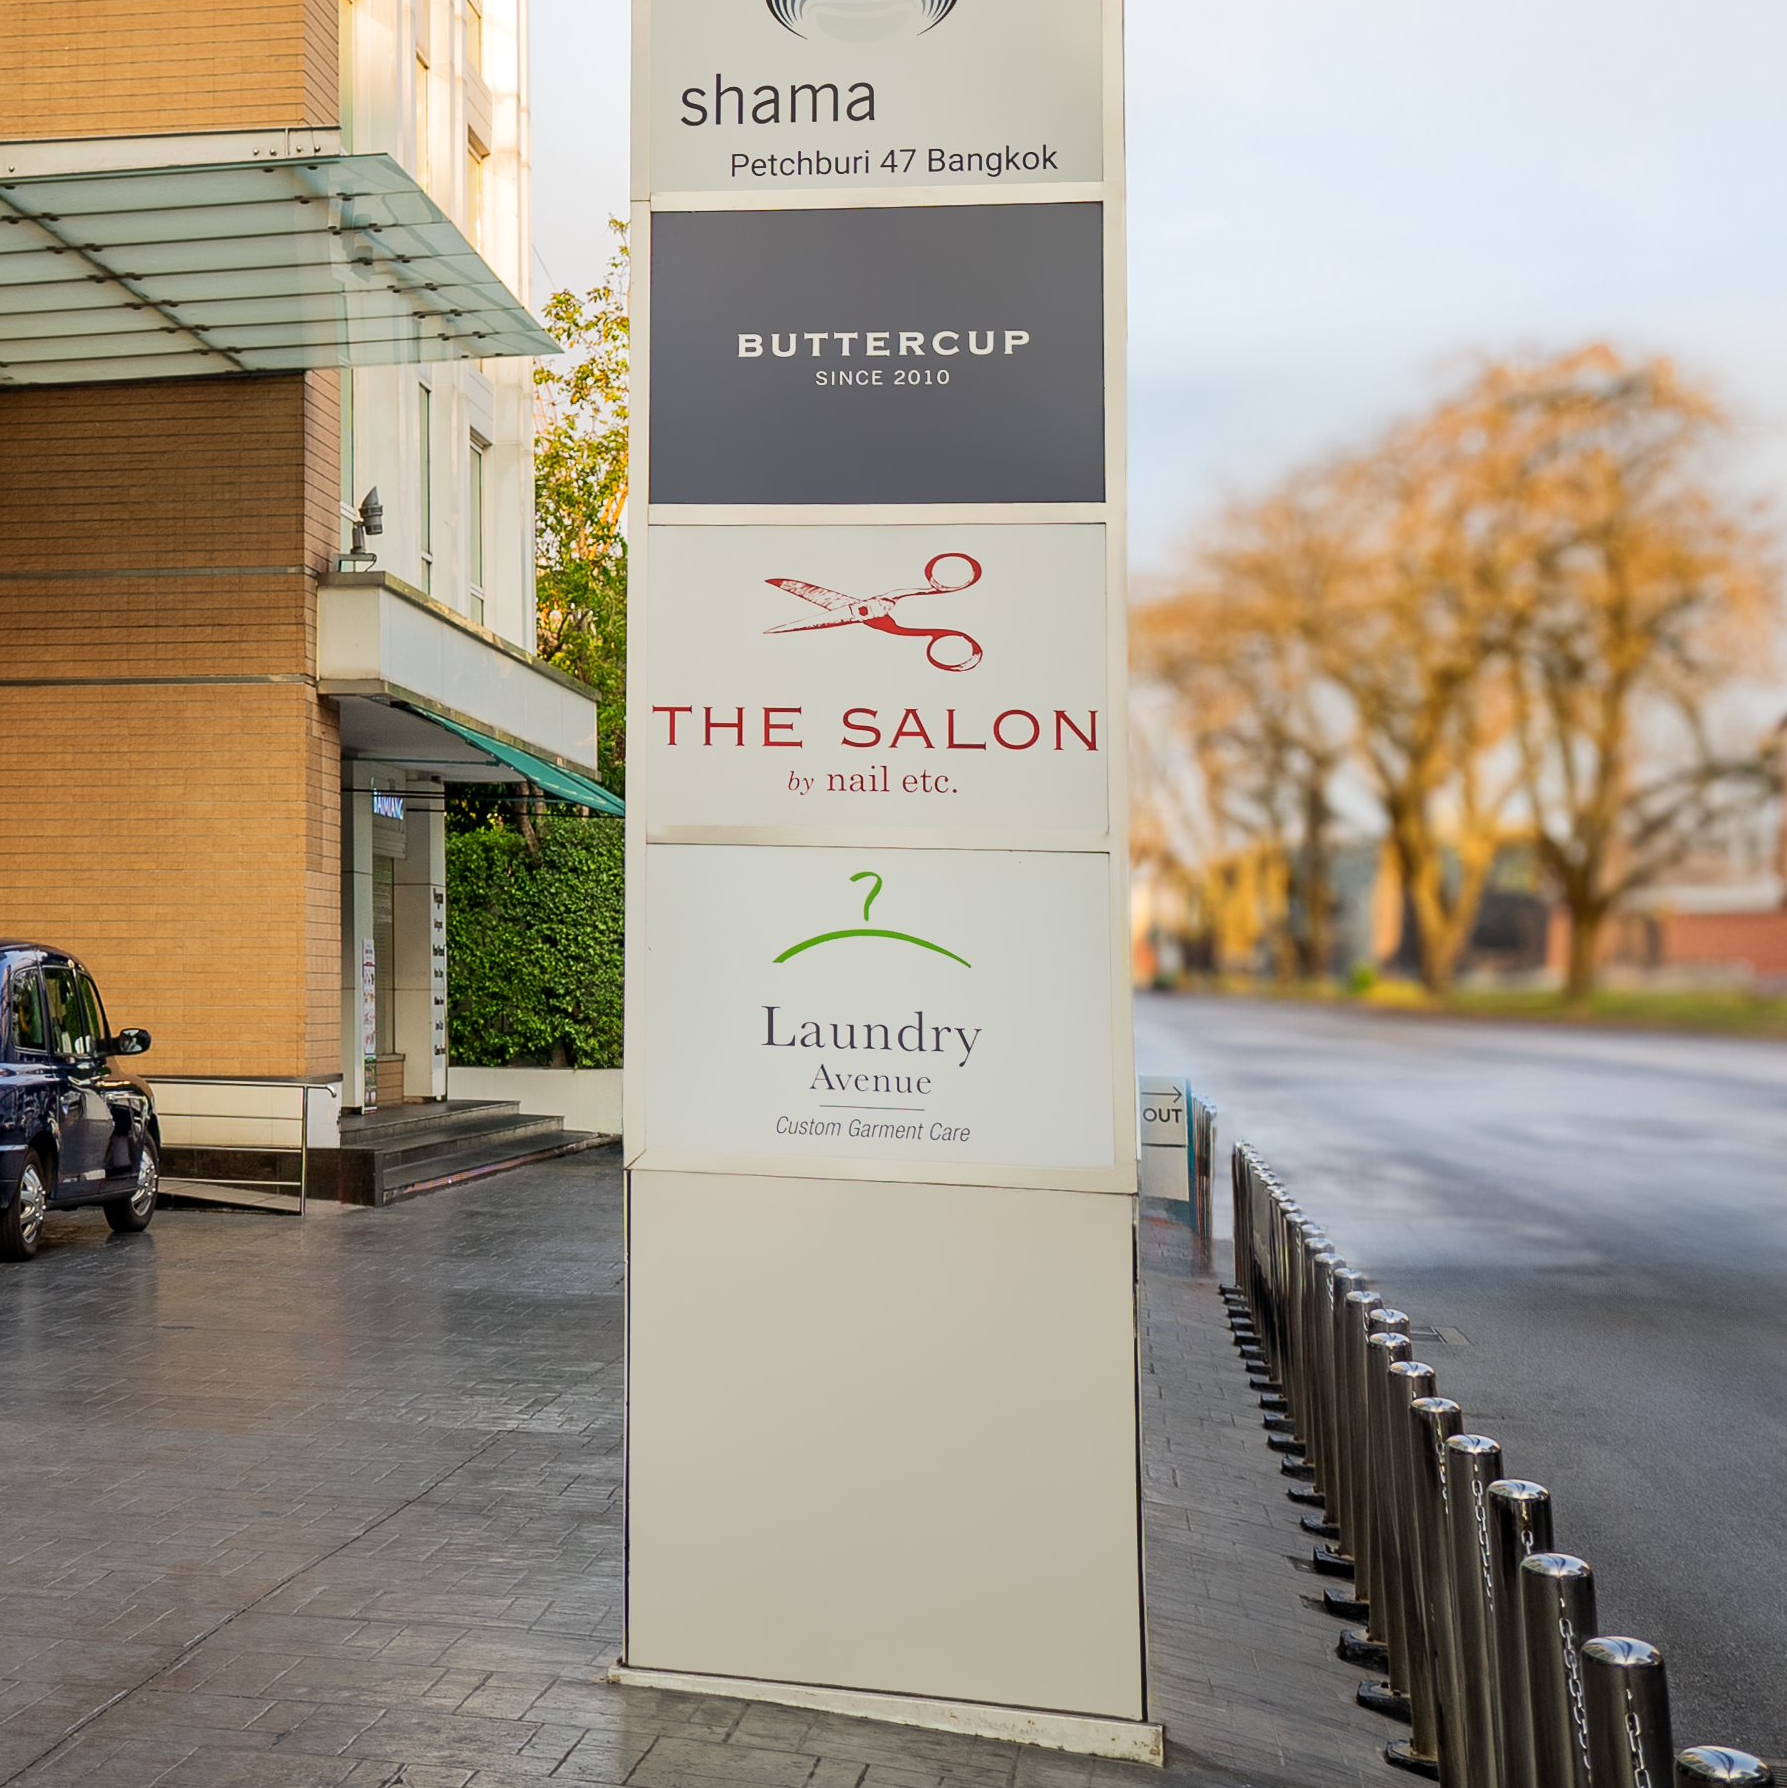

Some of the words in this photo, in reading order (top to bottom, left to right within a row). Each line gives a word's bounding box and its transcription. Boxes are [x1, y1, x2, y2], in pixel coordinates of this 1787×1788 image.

[680, 72, 876, 127] shama
[731, 149, 871, 178] Petchburi
[880, 148, 917, 174] 47
[927, 144, 1059, 178] Bangkok
[737, 329, 1031, 359] BUTTERCUP
[814, 369, 884, 387] SINCE
[893, 368, 950, 386] 2010
[652, 704, 804, 749] THE
[840, 707, 1099, 752] SALON
[787, 770, 815, 796] by
[826, 764, 891, 793] nail
[901, 768, 959, 794] etc.
[761, 1005, 983, 1072] Laundry
[809, 1063, 932, 1096] Avenue
[776, 1115, 842, 1138] Custom
[848, 1118, 925, 1142] Garment
[929, 1122, 971, 1143] Care
[1142, 1107, 1183, 1124] OUT
